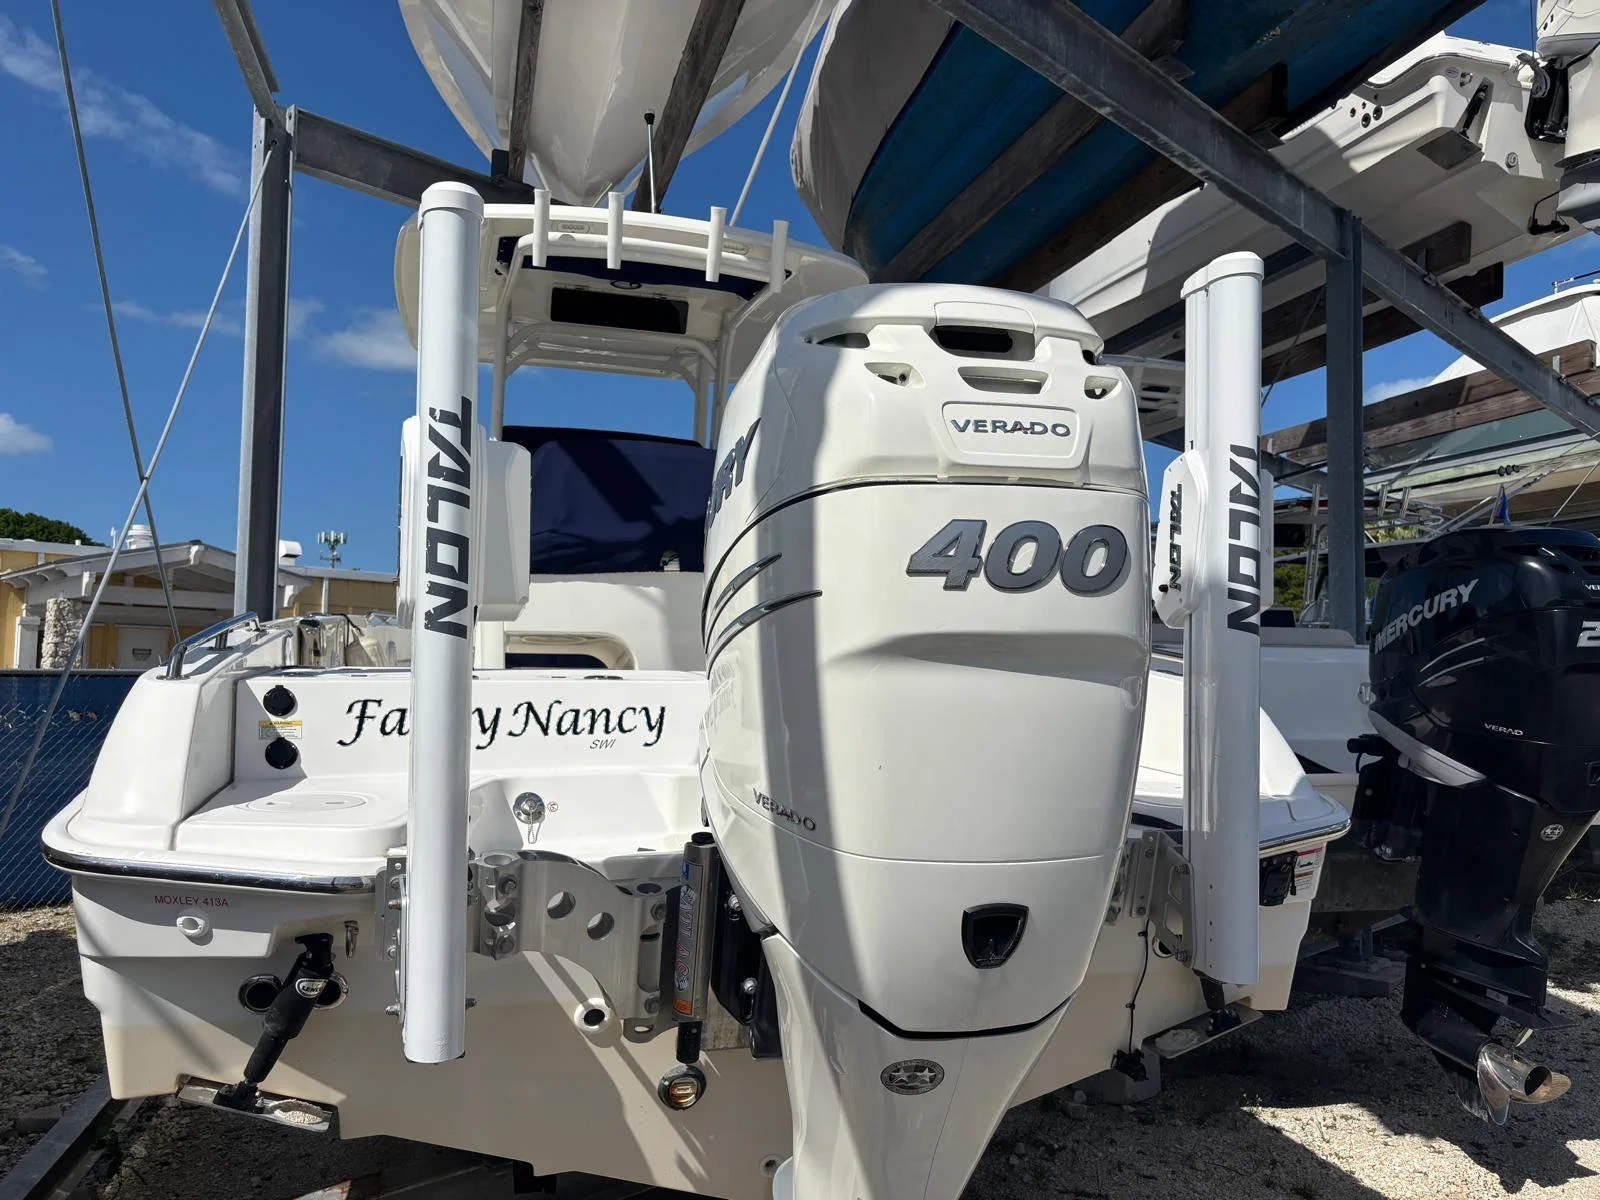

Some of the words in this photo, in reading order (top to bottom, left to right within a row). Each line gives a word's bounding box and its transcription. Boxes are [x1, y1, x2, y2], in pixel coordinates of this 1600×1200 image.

[950, 418, 1071, 437] VERADO
[424, 396, 472, 639] TALON
[906, 518, 1129, 595] 400
[1374, 578, 1480, 654] MERCURY
[337, 699, 502, 750] Fay
[506, 700, 667, 747] Nancy
[752, 788, 817, 832] VERADO
[154, 895, 200, 906] MOXLEY
[202, 898, 229, 907] 413A
